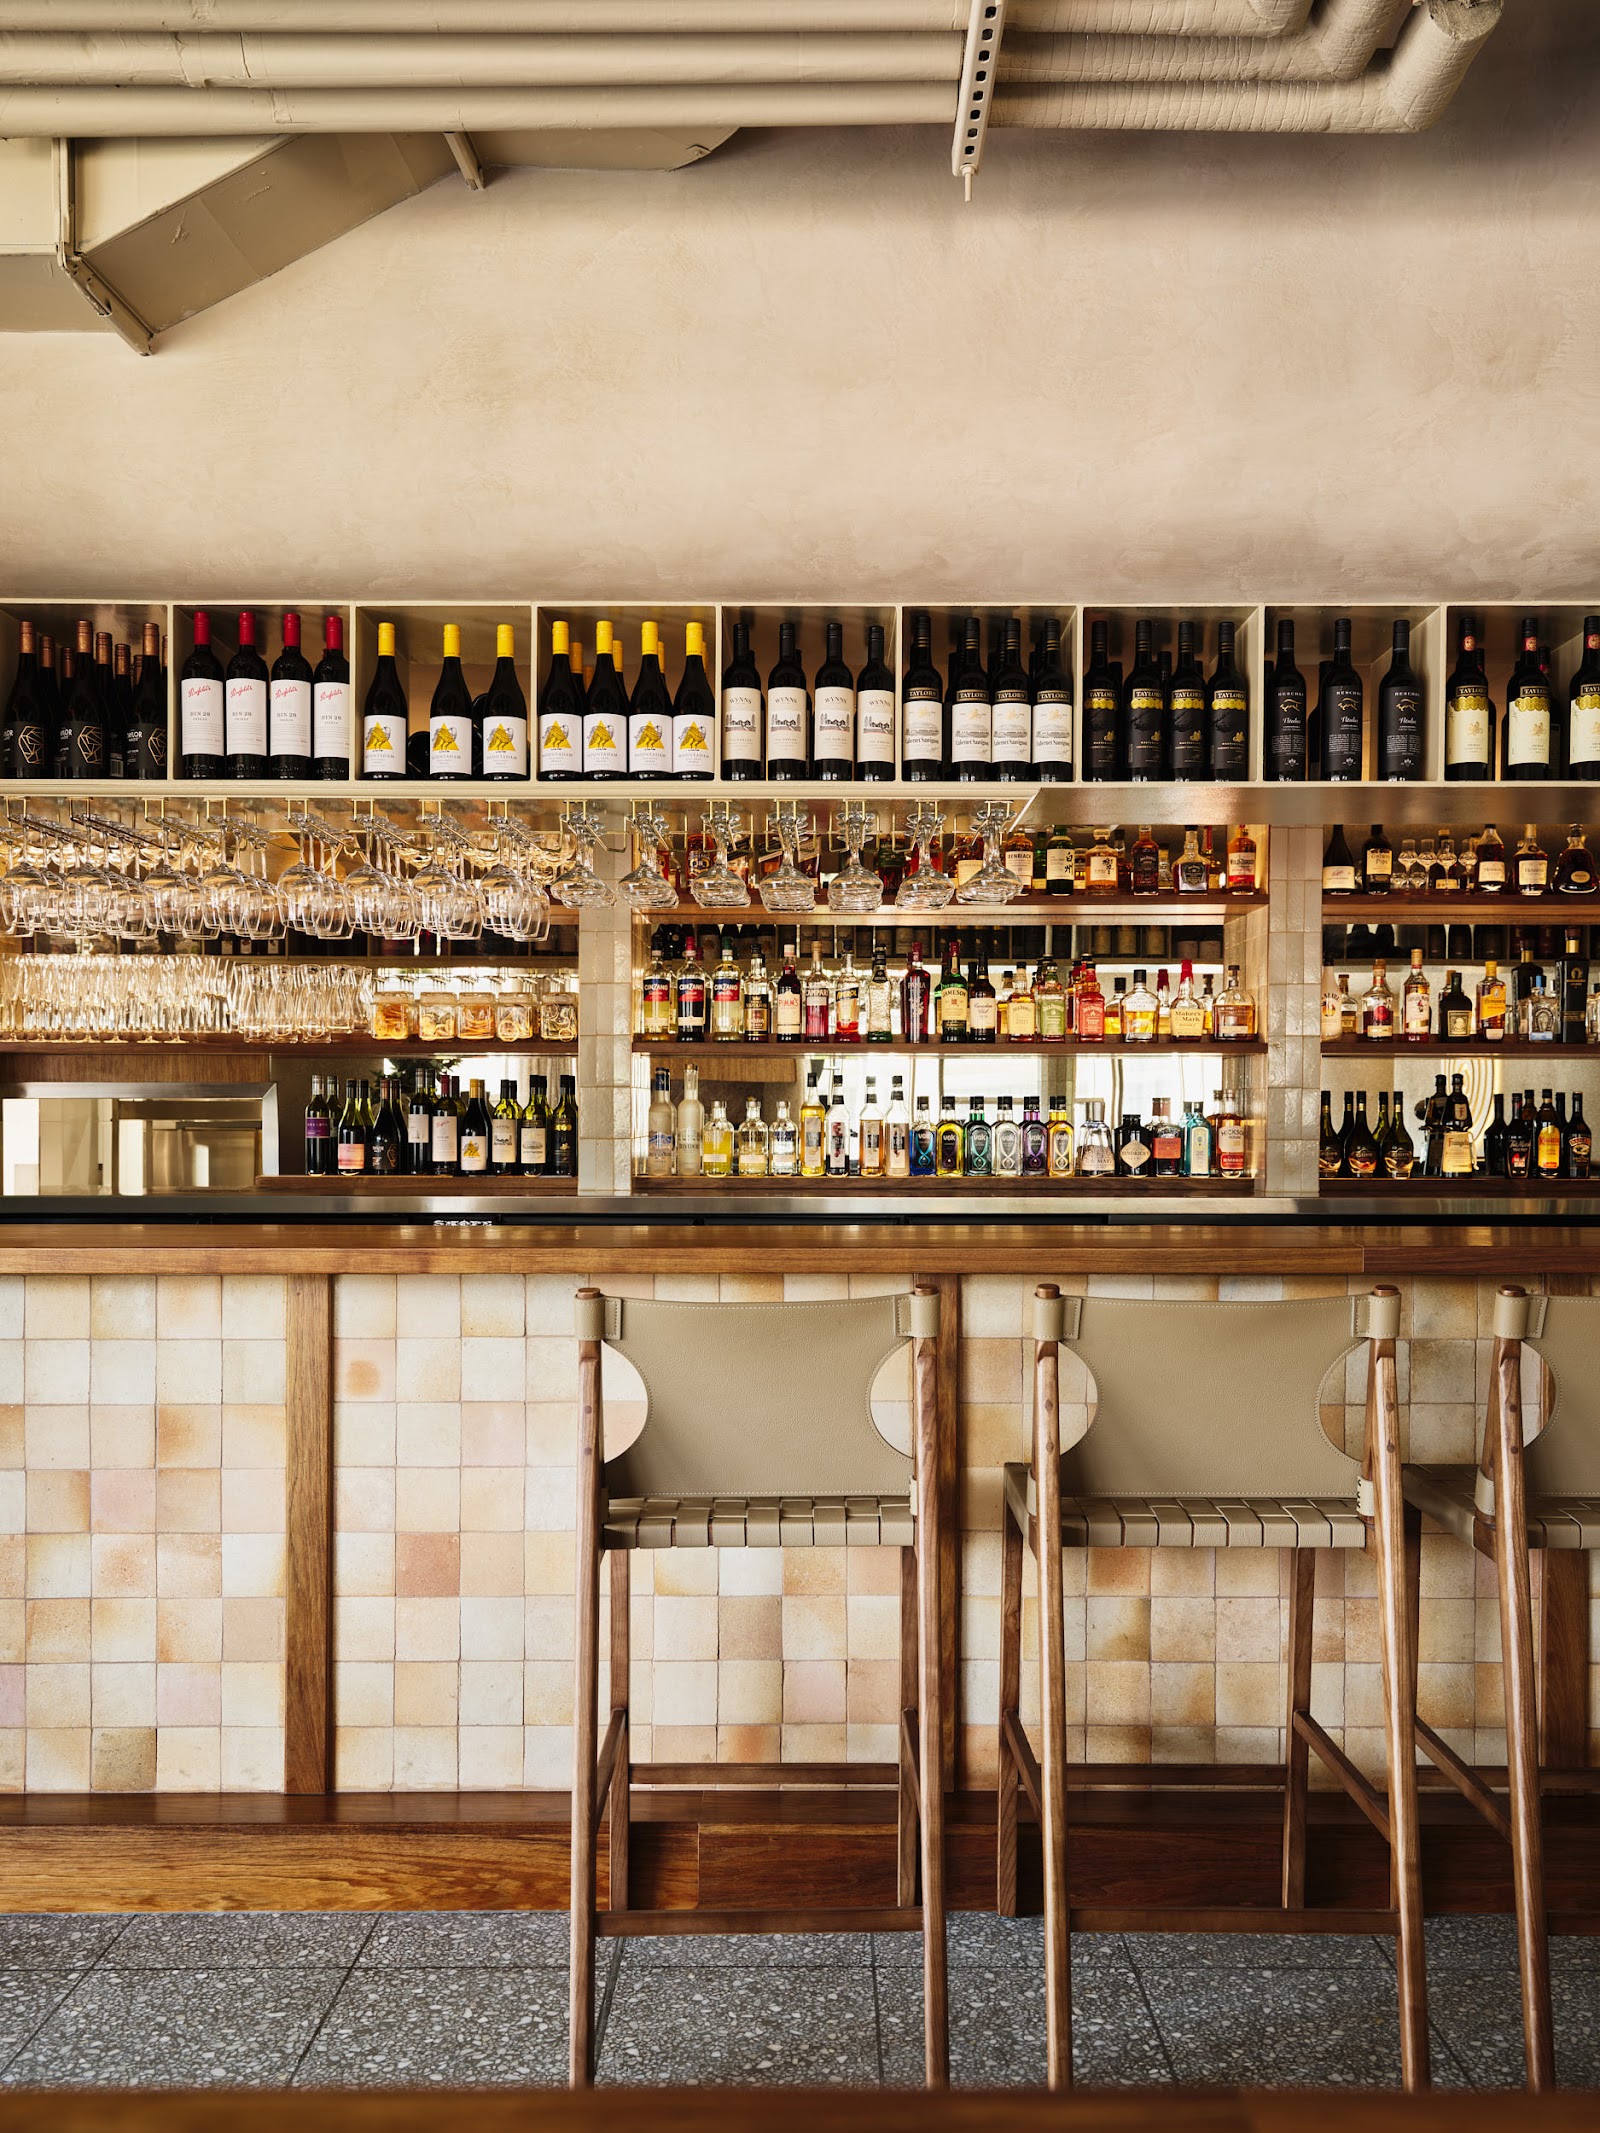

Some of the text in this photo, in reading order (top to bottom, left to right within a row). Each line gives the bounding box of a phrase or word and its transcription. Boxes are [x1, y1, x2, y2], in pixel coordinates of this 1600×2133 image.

[729, 696, 752, 704] WYNNS
[775, 696, 798, 704] WYNNS
[824, 696, 847, 704] WYNNS
[644, 983, 669, 992] CINZANO
[679, 983, 704, 992] CINZANO
[714, 982, 739, 991] CINZANO
[943, 989, 966, 997] JAMESON
[918, 1132, 931, 1140] vok
[943, 1133, 956, 1141] vok
[973, 1132, 987, 1140] vok
[999, 1133, 1012, 1141] vok
[1028, 1132, 1042, 1141] vok
[1054, 1133, 1068, 1141] vok
